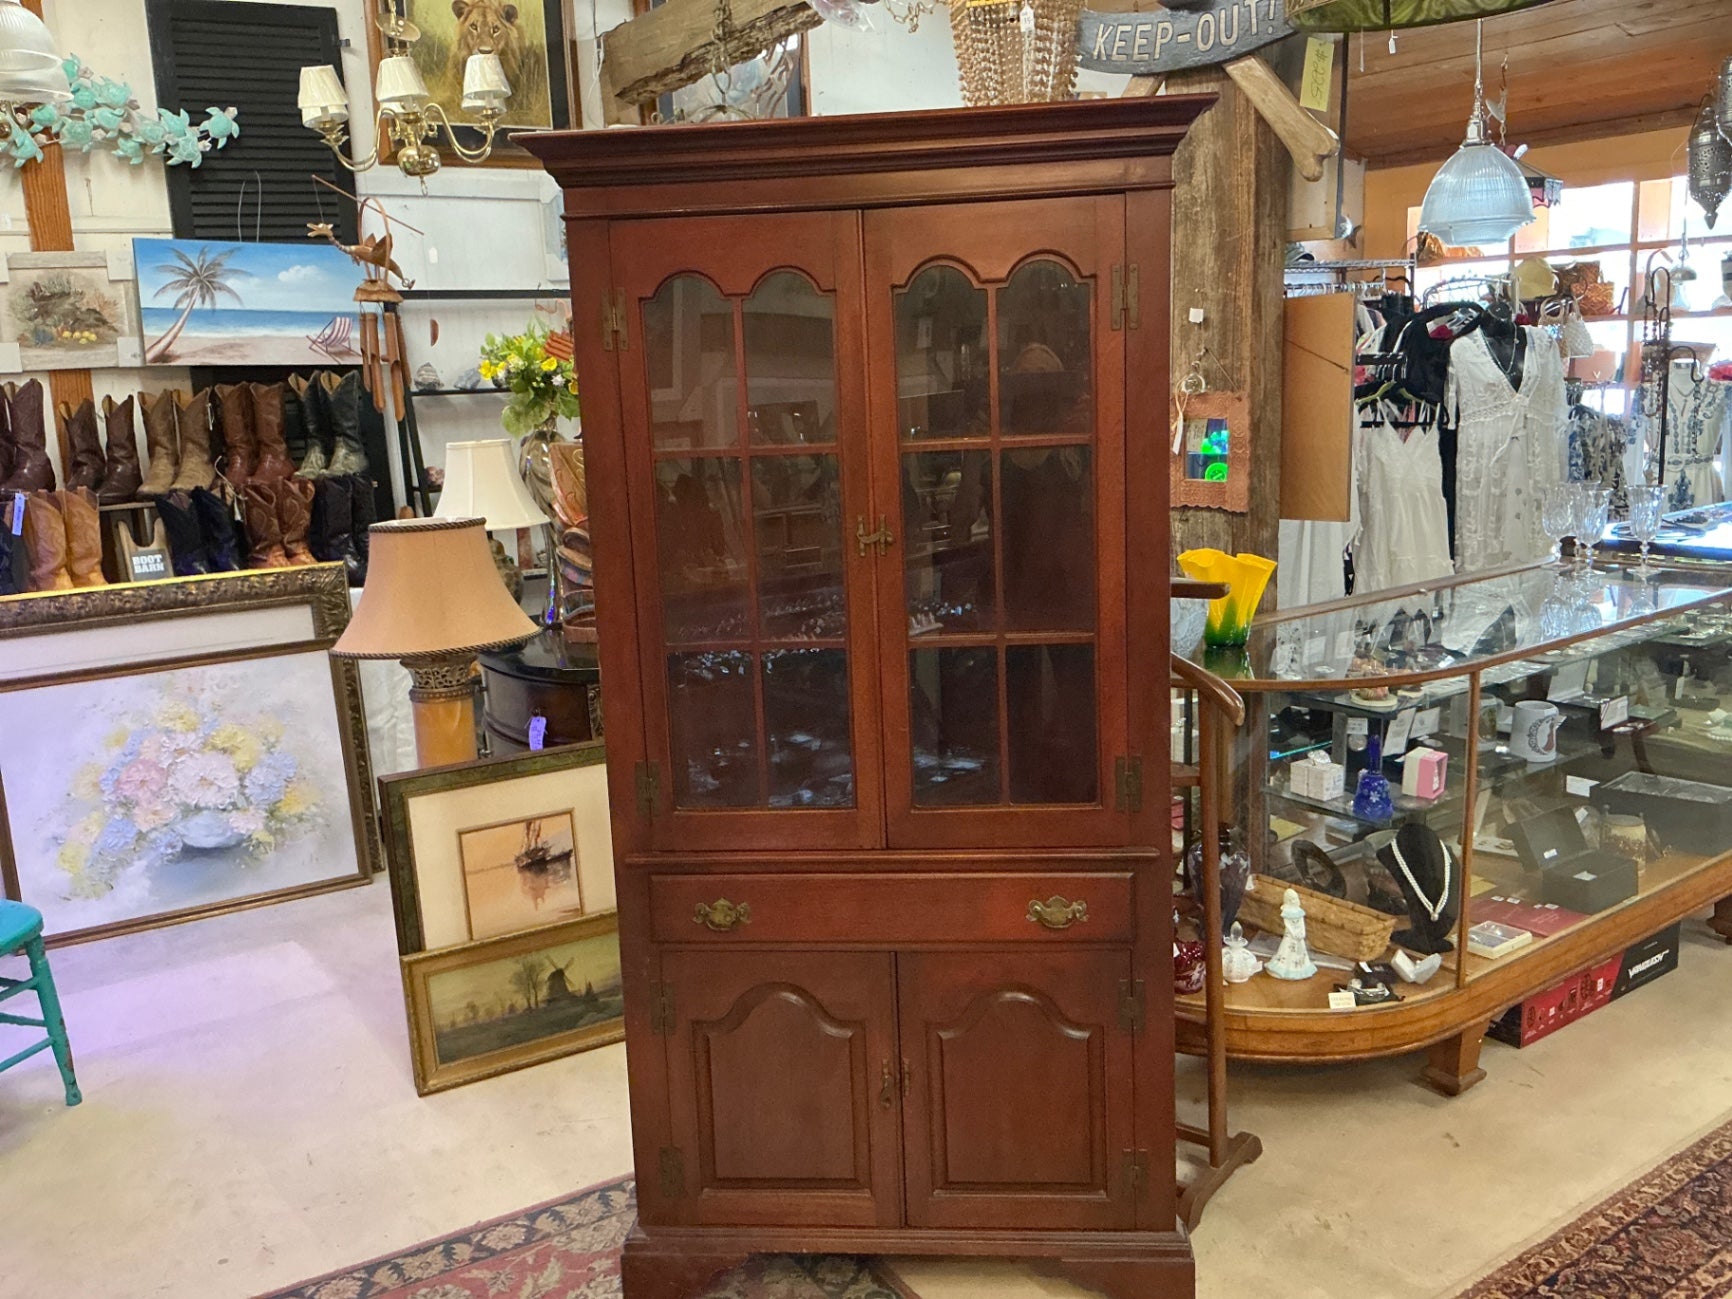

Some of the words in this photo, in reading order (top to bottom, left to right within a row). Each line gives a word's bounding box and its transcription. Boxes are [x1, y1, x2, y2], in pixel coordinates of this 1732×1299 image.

[1092, 0, 1276, 62] KEEP-OUT!
[132, 554, 163, 567] BOOT
[134, 562, 165, 574] BARN
